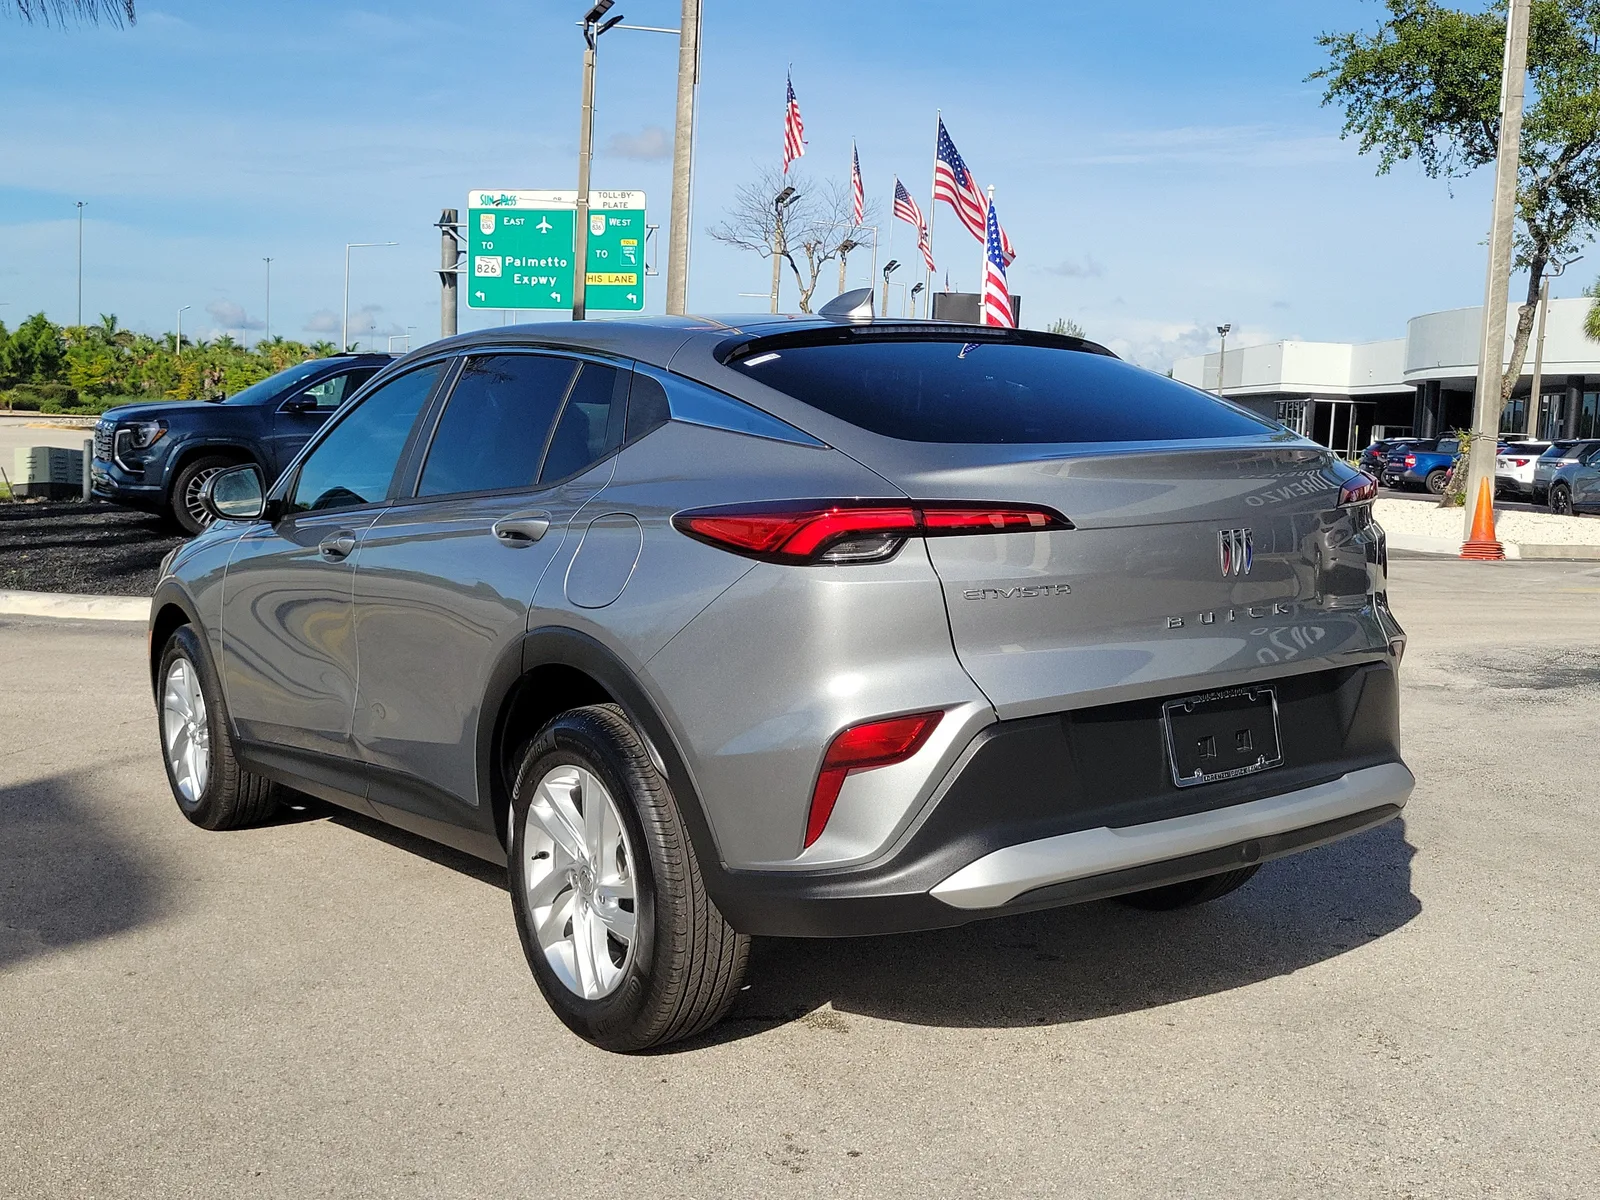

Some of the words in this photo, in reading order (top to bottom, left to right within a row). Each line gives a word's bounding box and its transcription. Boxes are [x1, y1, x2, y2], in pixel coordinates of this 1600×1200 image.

[598, 191, 634, 199] TOLL-BY-
[602, 201, 629, 209] PLATE
[503, 216, 526, 226] EAST
[608, 217, 632, 227] WEST
[481, 241, 494, 250] TO
[595, 249, 608, 259] TO
[505, 256, 567, 267] Palmetto
[476, 264, 497, 274] 826
[513, 273, 557, 287] Expwy
[587, 275, 603, 283] HIS
[608, 275, 634, 284] LANE
[963, 584, 1071, 601] ENVISTA
[1166, 603, 1289, 629] BUICK
